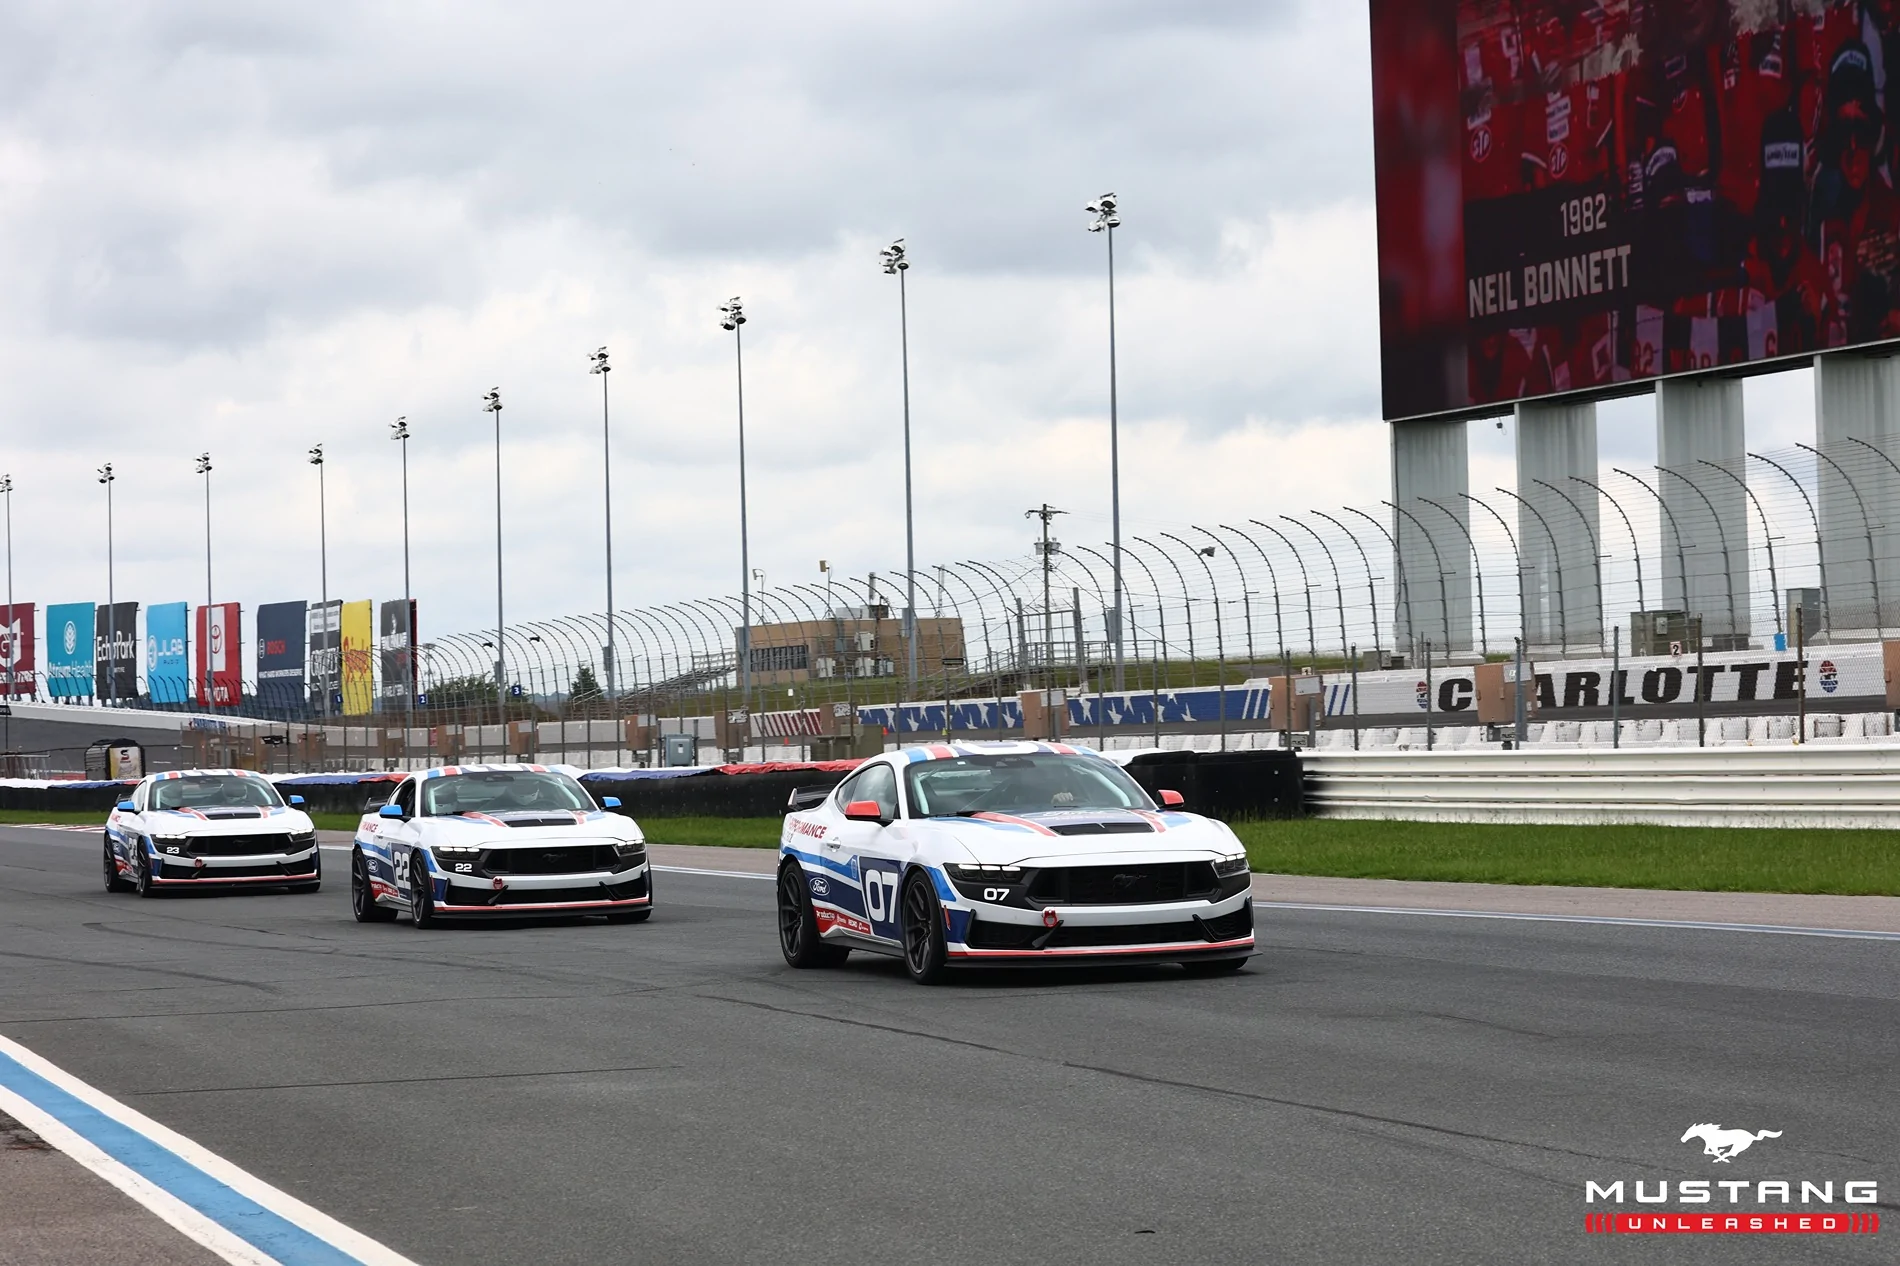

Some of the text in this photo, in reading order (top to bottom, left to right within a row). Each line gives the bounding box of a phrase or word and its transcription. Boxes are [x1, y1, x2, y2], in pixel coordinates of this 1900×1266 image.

[1560, 194, 1607, 237] 1982
[1469, 245, 1632, 319] NEIL BONNETT
[1672, 645, 1679, 656] 2
[48, 662, 71, 678] Atrium
[71, 660, 93, 678] Health
[1438, 661, 1809, 712] CARLOTTE
[166, 846, 180, 855] 23
[393, 851, 411, 890] 22
[455, 863, 473, 873] 22
[865, 869, 898, 924] 07
[983, 887, 1010, 901] 07
